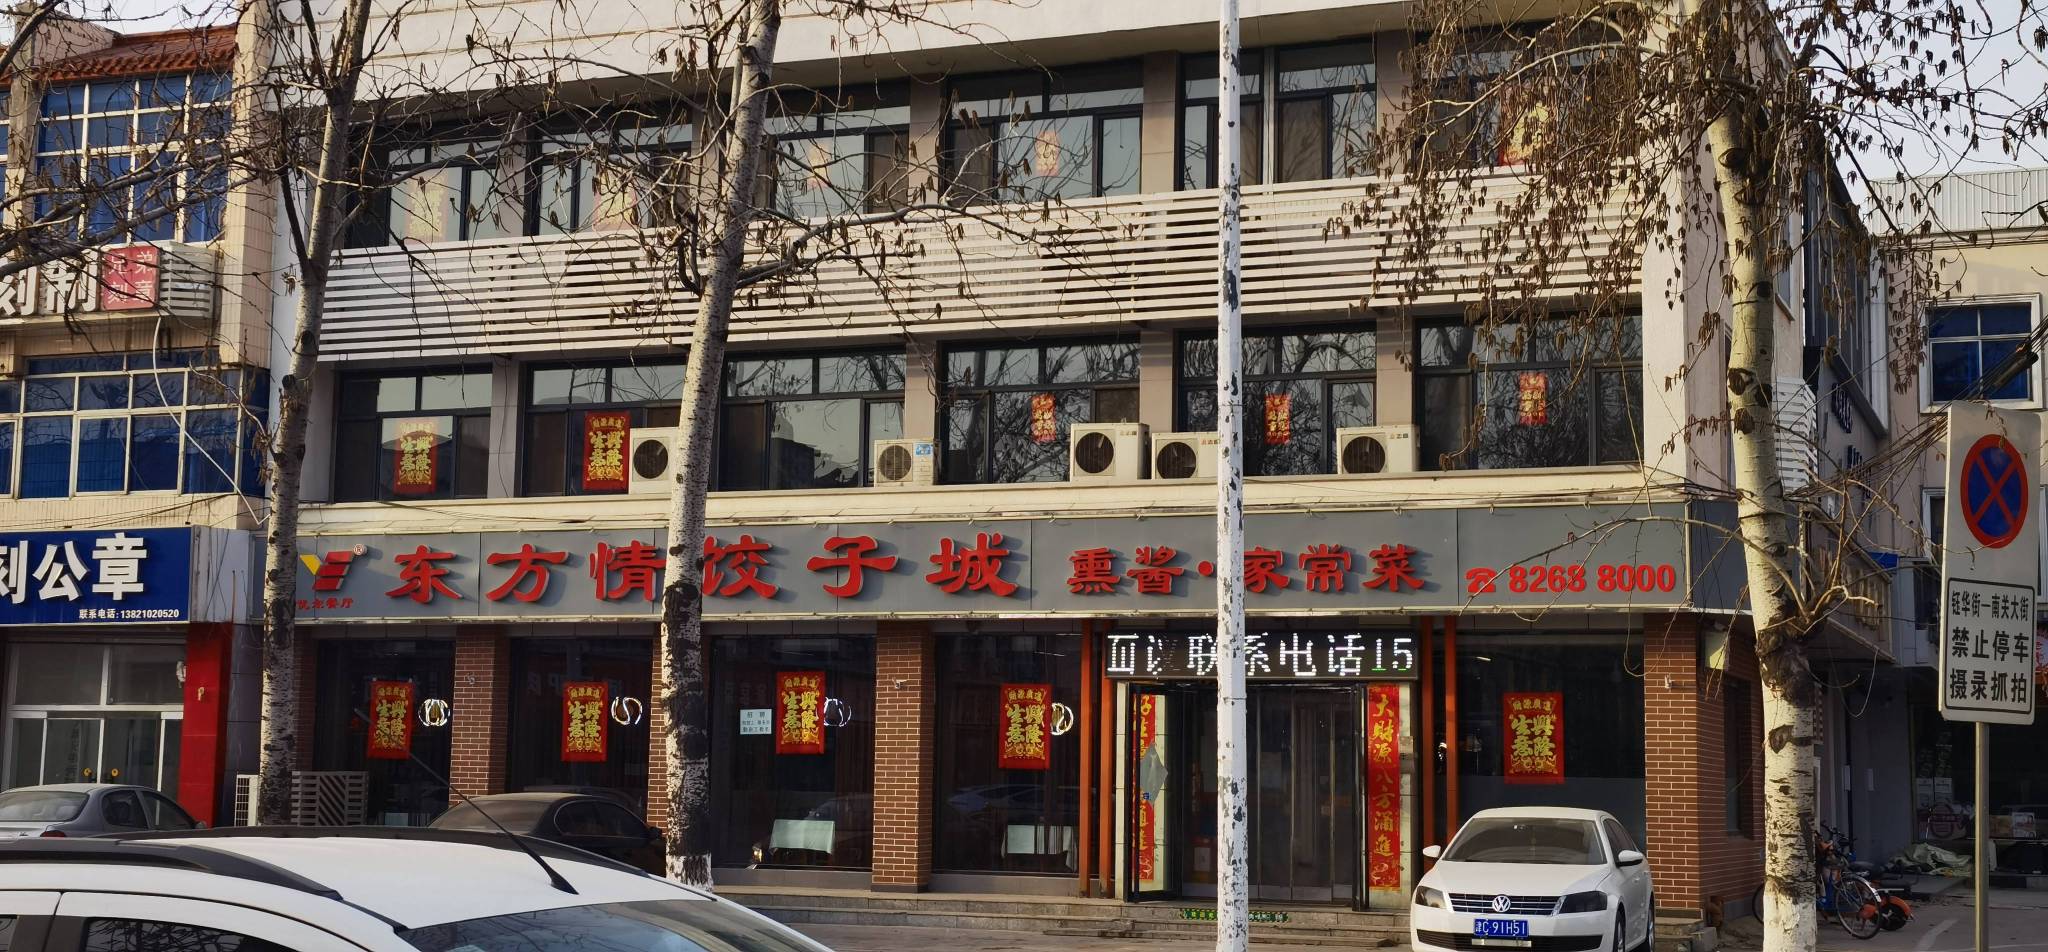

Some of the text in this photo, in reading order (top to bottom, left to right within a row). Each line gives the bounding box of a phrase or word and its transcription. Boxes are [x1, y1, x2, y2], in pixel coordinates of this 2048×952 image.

[385, 531, 1019, 604] 东方情饺子城
[1508, 564, 1676, 594] 8268 8000
[1952, 626, 2029, 663] 禁止停车
[1950, 668, 2027, 703] 摄录抓拍
